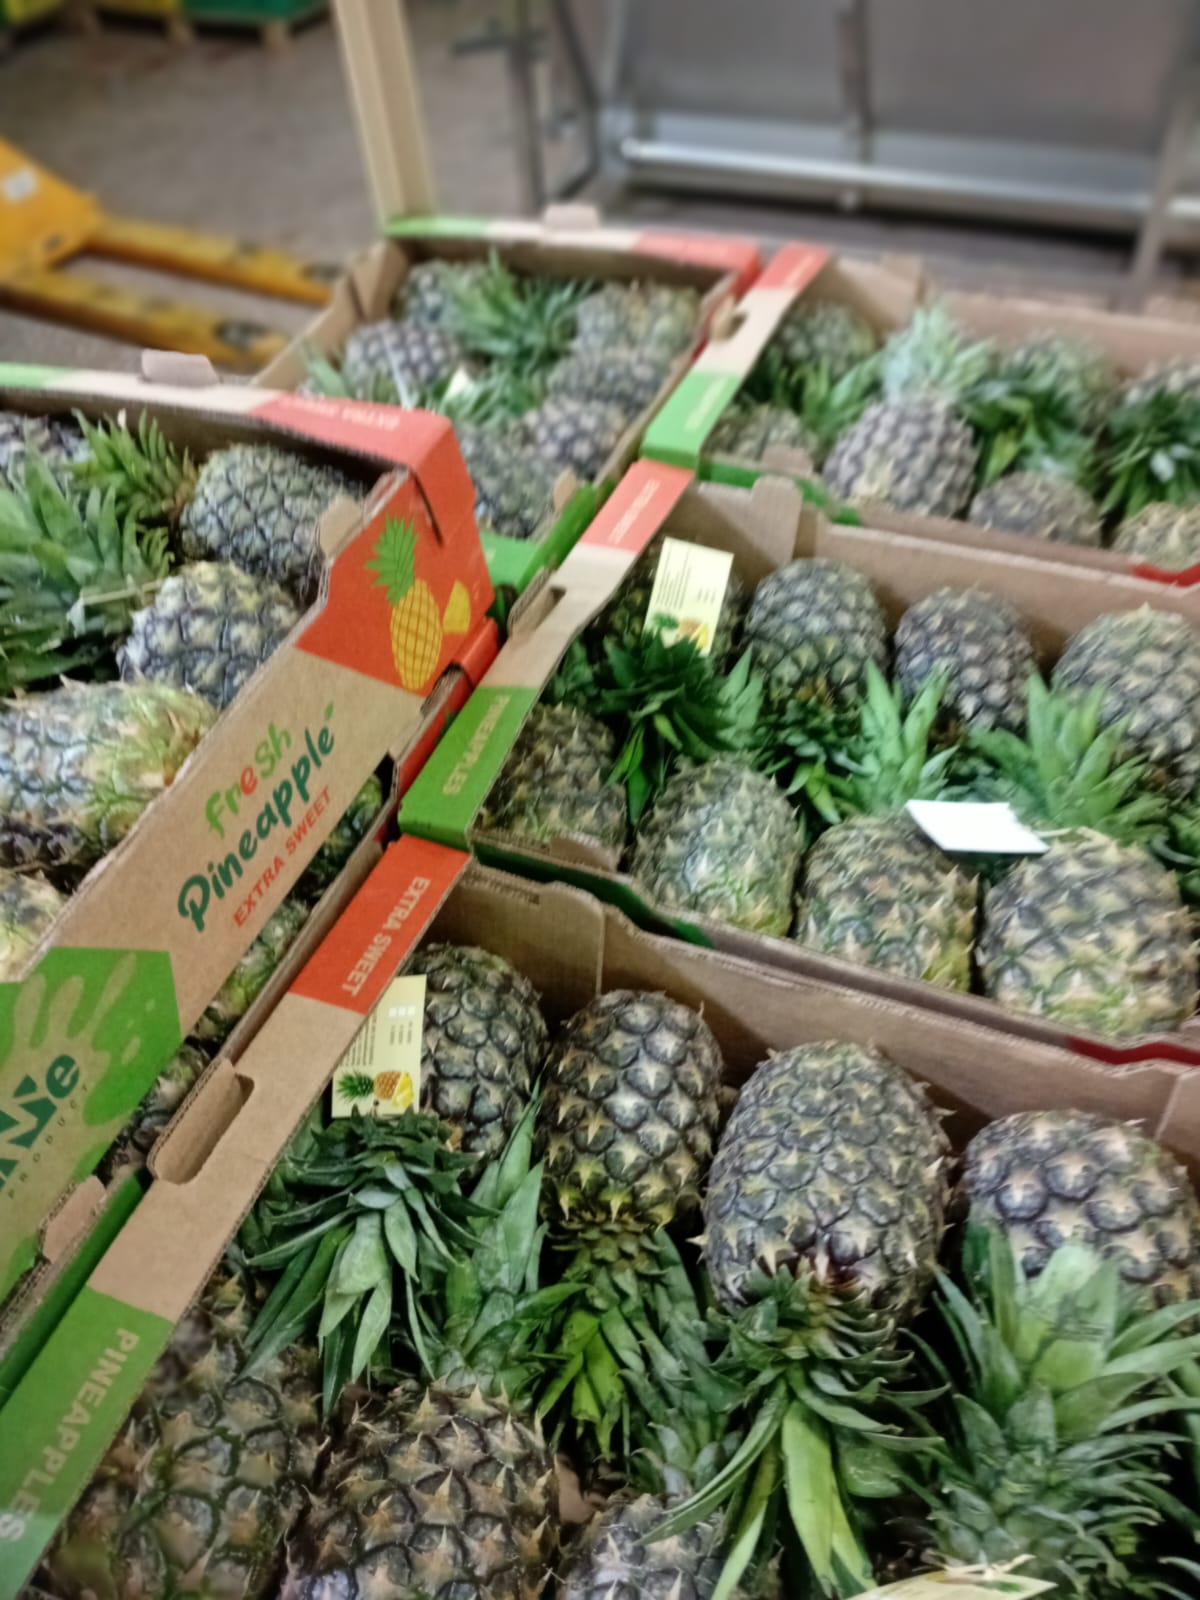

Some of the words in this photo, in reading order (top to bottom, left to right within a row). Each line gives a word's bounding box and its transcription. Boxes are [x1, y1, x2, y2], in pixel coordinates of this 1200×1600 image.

[232, 855, 286, 928] EXTRA
[284, 784, 332, 855] SWEET
[382, 876, 431, 930] EXTRA
[342, 932, 392, 997] SWEET
